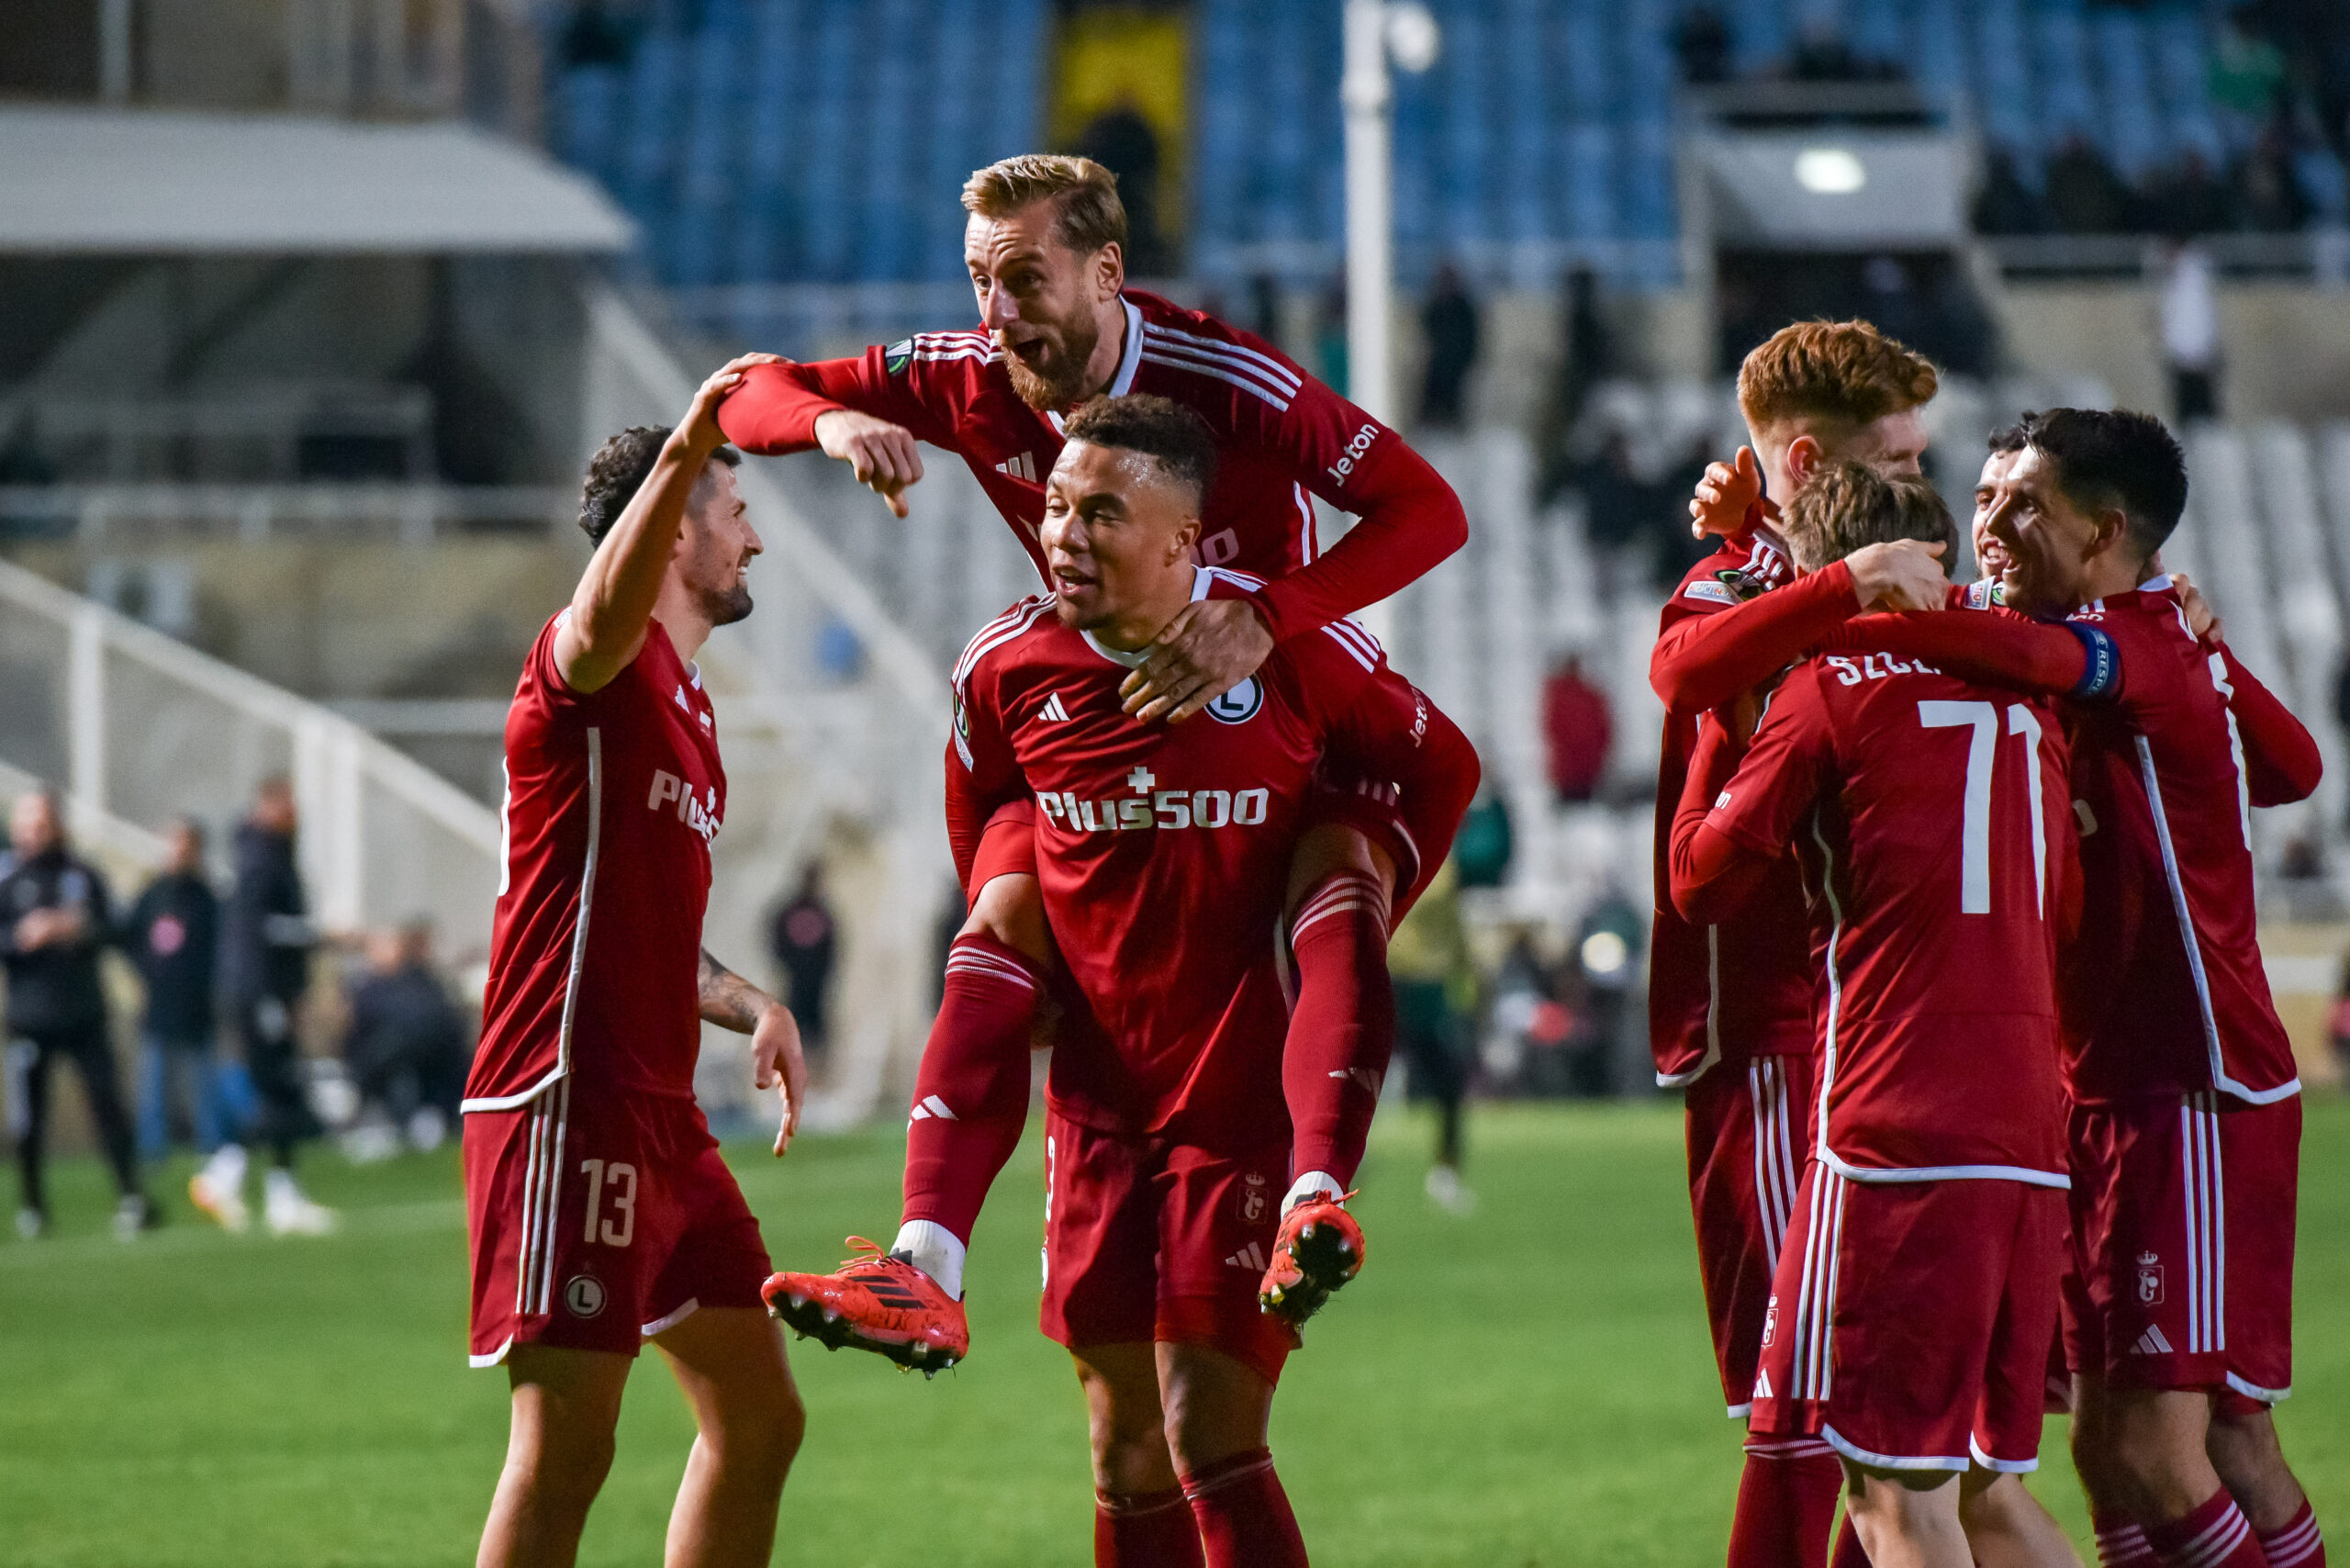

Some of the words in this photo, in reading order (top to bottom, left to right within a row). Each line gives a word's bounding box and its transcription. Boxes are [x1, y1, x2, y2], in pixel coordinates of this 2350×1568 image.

[1327, 423, 1379, 487] Jeton
[1035, 788, 1270, 832] Plus500
[1918, 700, 2046, 921] 71
[580, 1159, 637, 1248] 13
